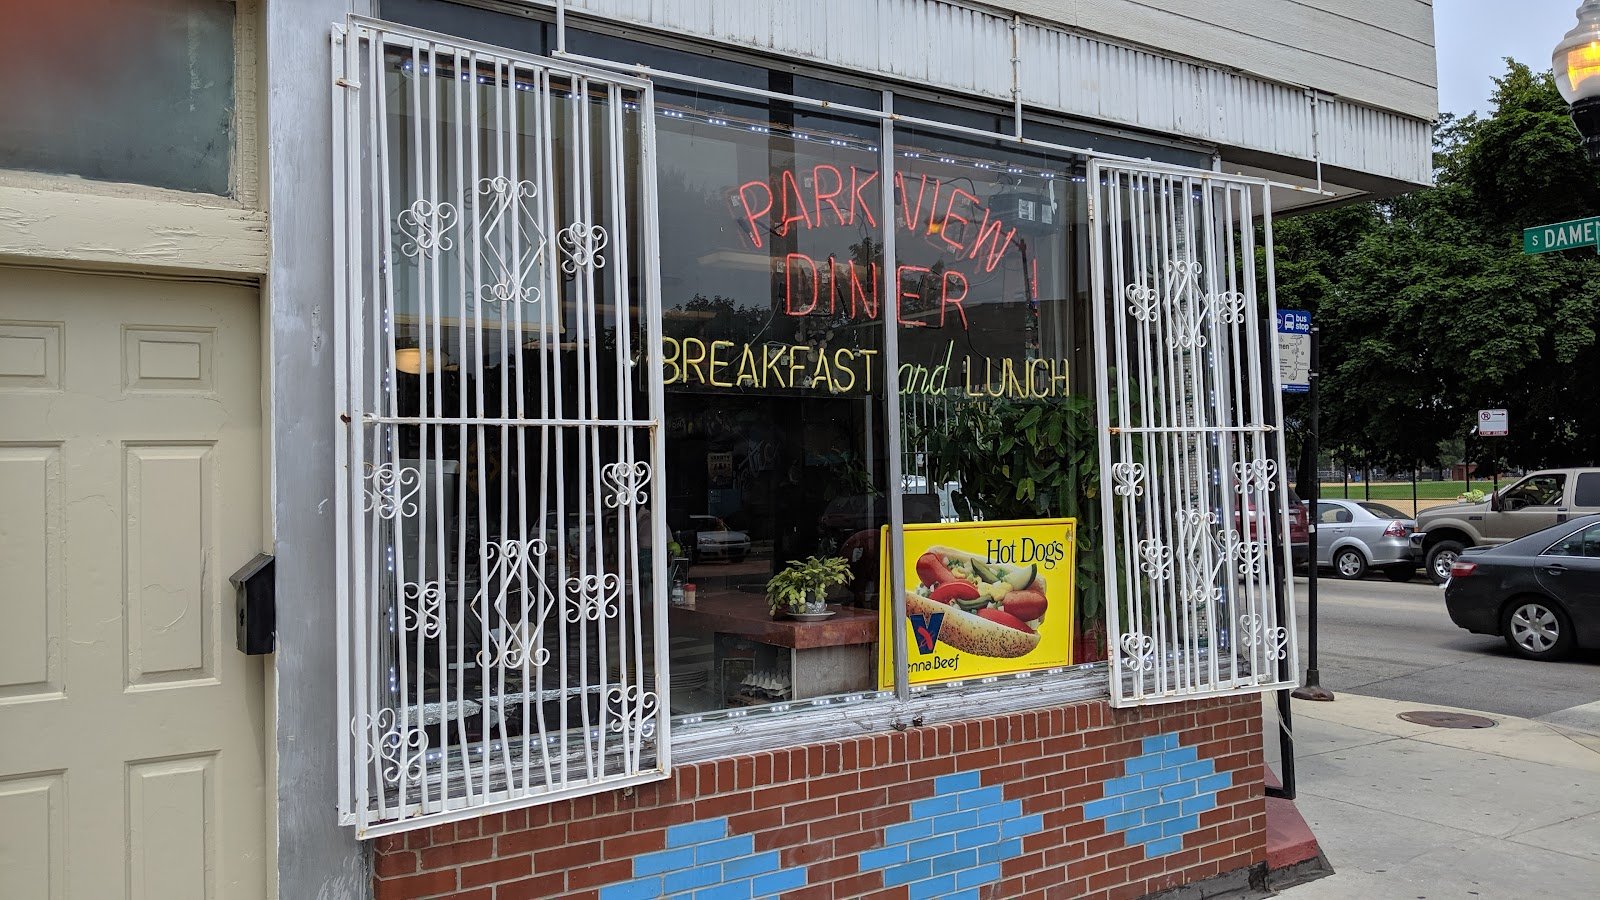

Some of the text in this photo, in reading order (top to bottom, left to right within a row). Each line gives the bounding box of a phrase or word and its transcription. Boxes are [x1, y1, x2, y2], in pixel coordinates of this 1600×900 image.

[1532, 221, 1600, 248] S DAME
[785, 253, 968, 331] DINER
[1295, 314, 1307, 323] bus
[1295, 323, 1309, 332] stop
[662, 336, 1070, 398] BREAKFAST and LUNCH
[986, 537, 1064, 570] Hot Dogs
[934, 654, 960, 671] Beef
